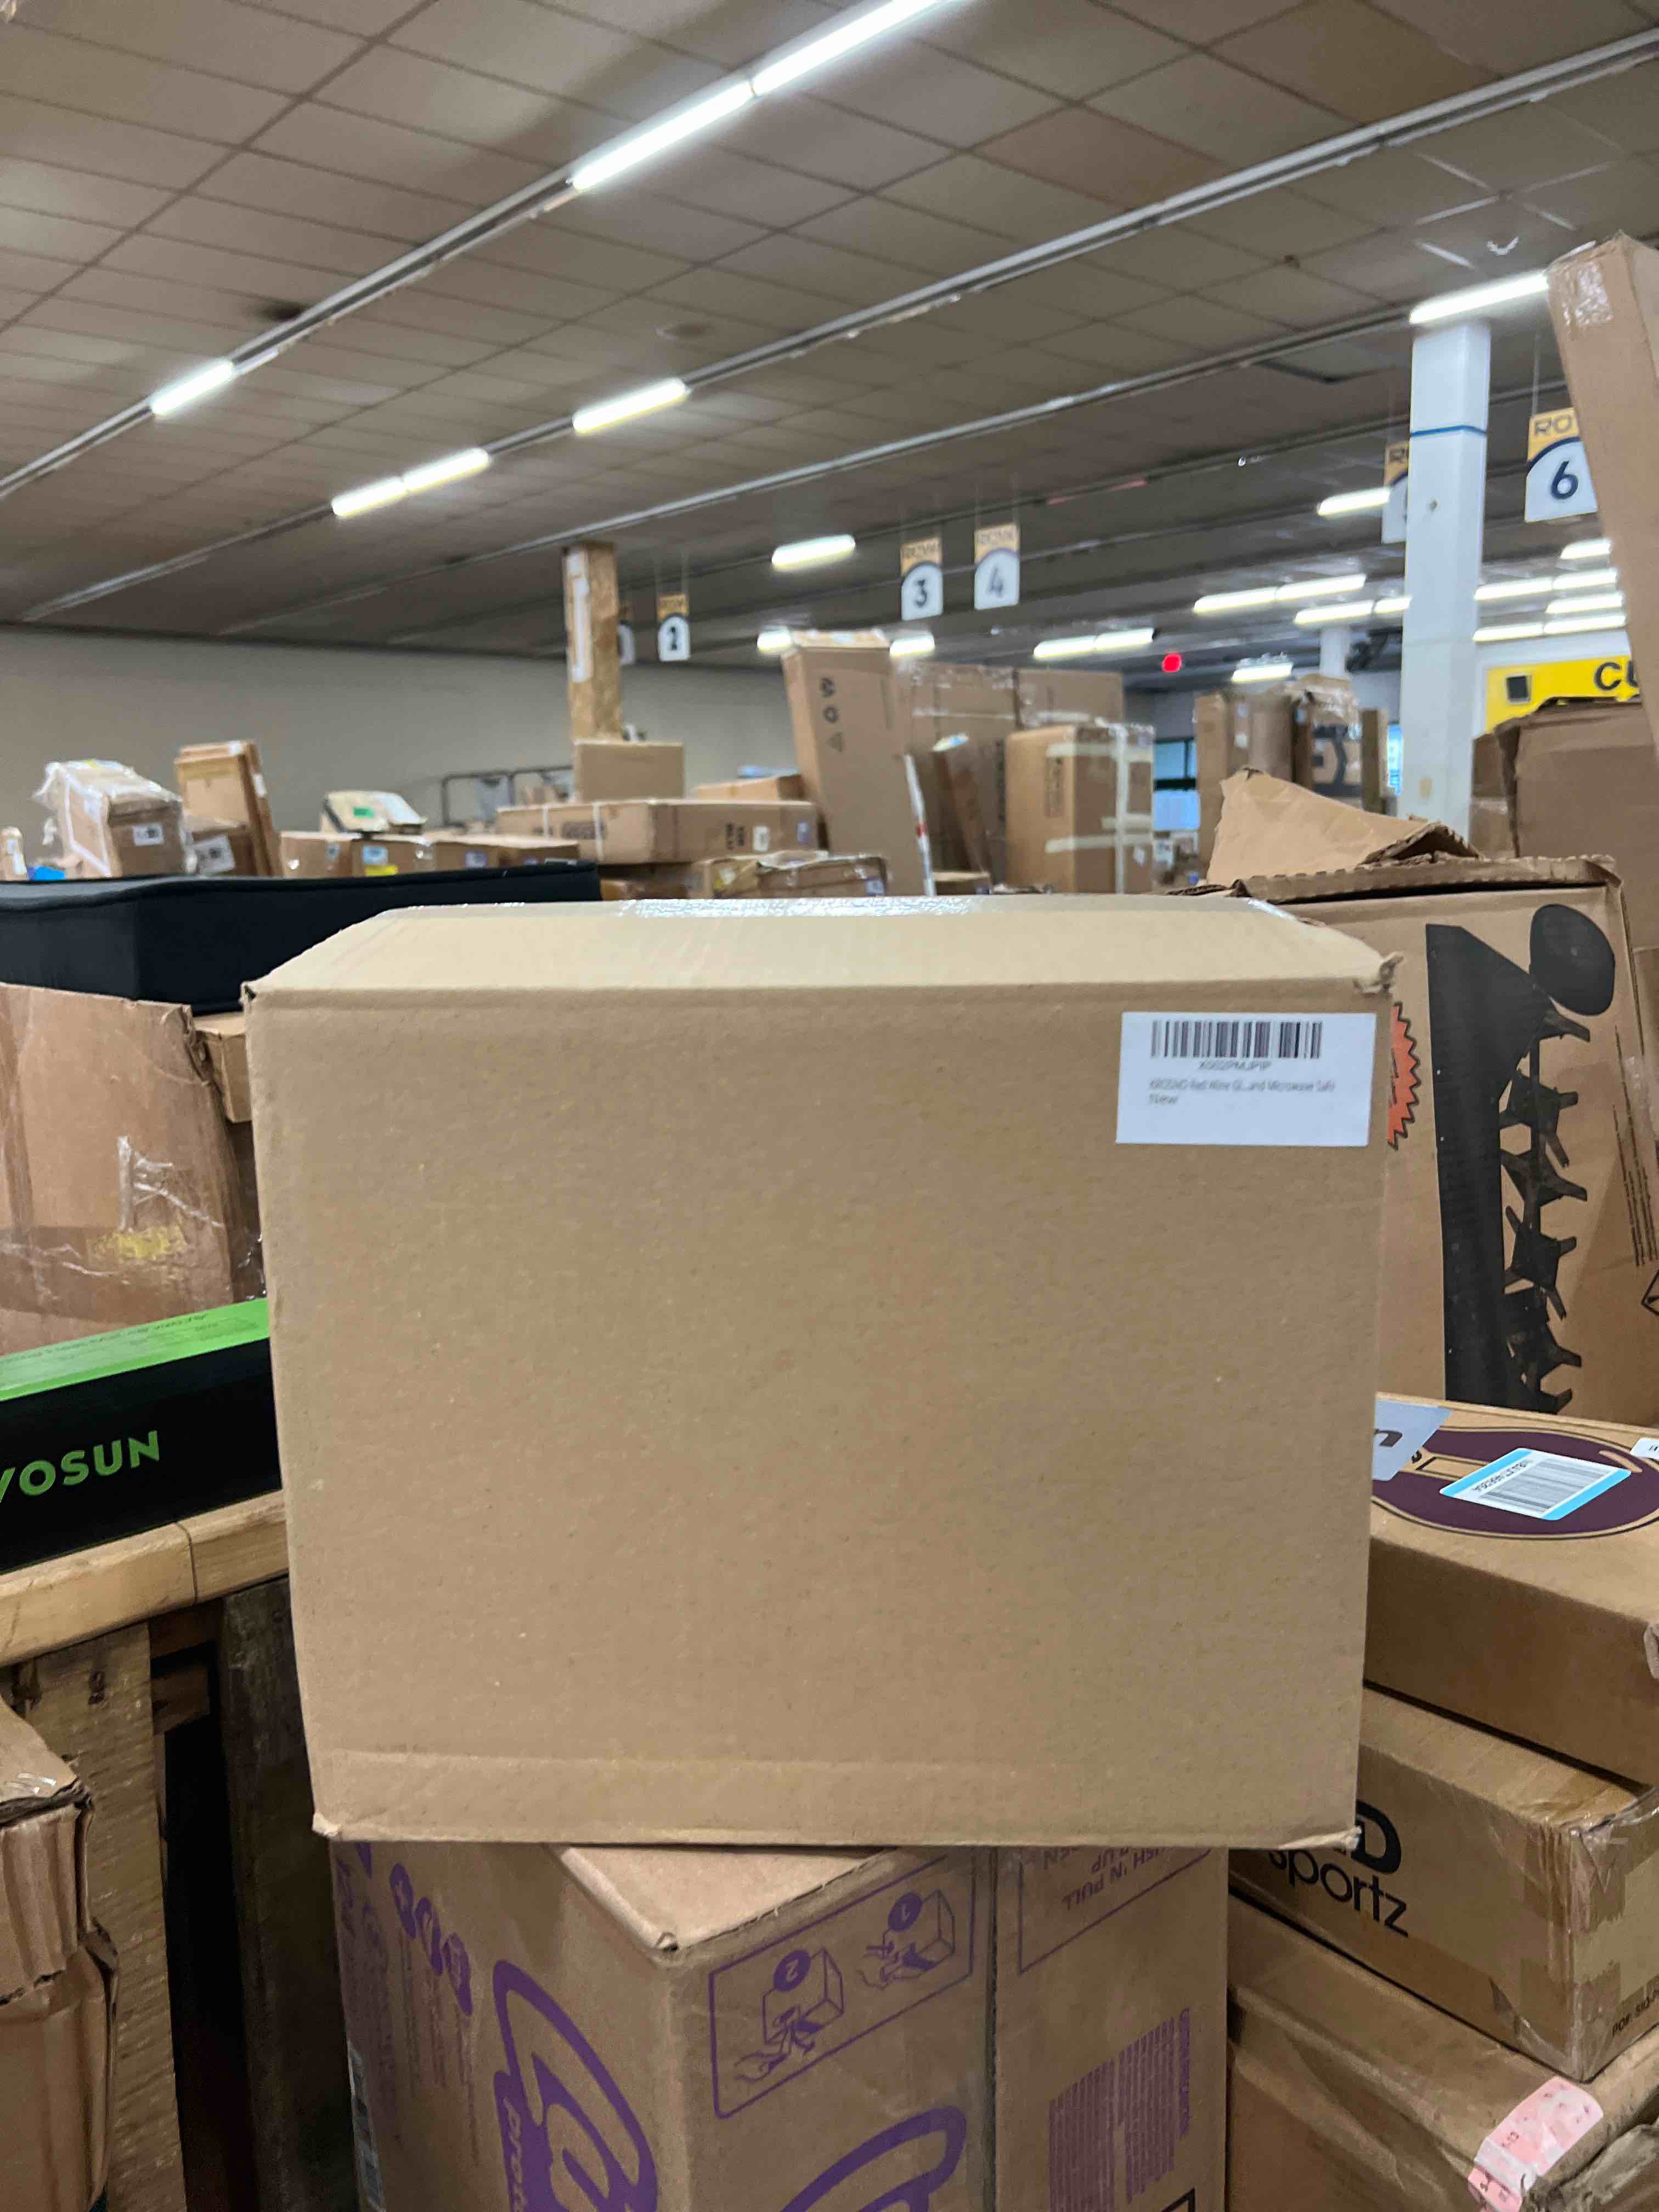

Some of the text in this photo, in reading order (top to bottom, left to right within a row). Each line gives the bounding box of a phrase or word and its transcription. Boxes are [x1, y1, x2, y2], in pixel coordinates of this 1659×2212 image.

[1534, 415, 1572, 436] RO
[1551, 460, 1578, 500] 6
[914, 578, 929, 608] 3
[985, 565, 1004, 599] 4
[785, 1957, 800, 1983] 2
